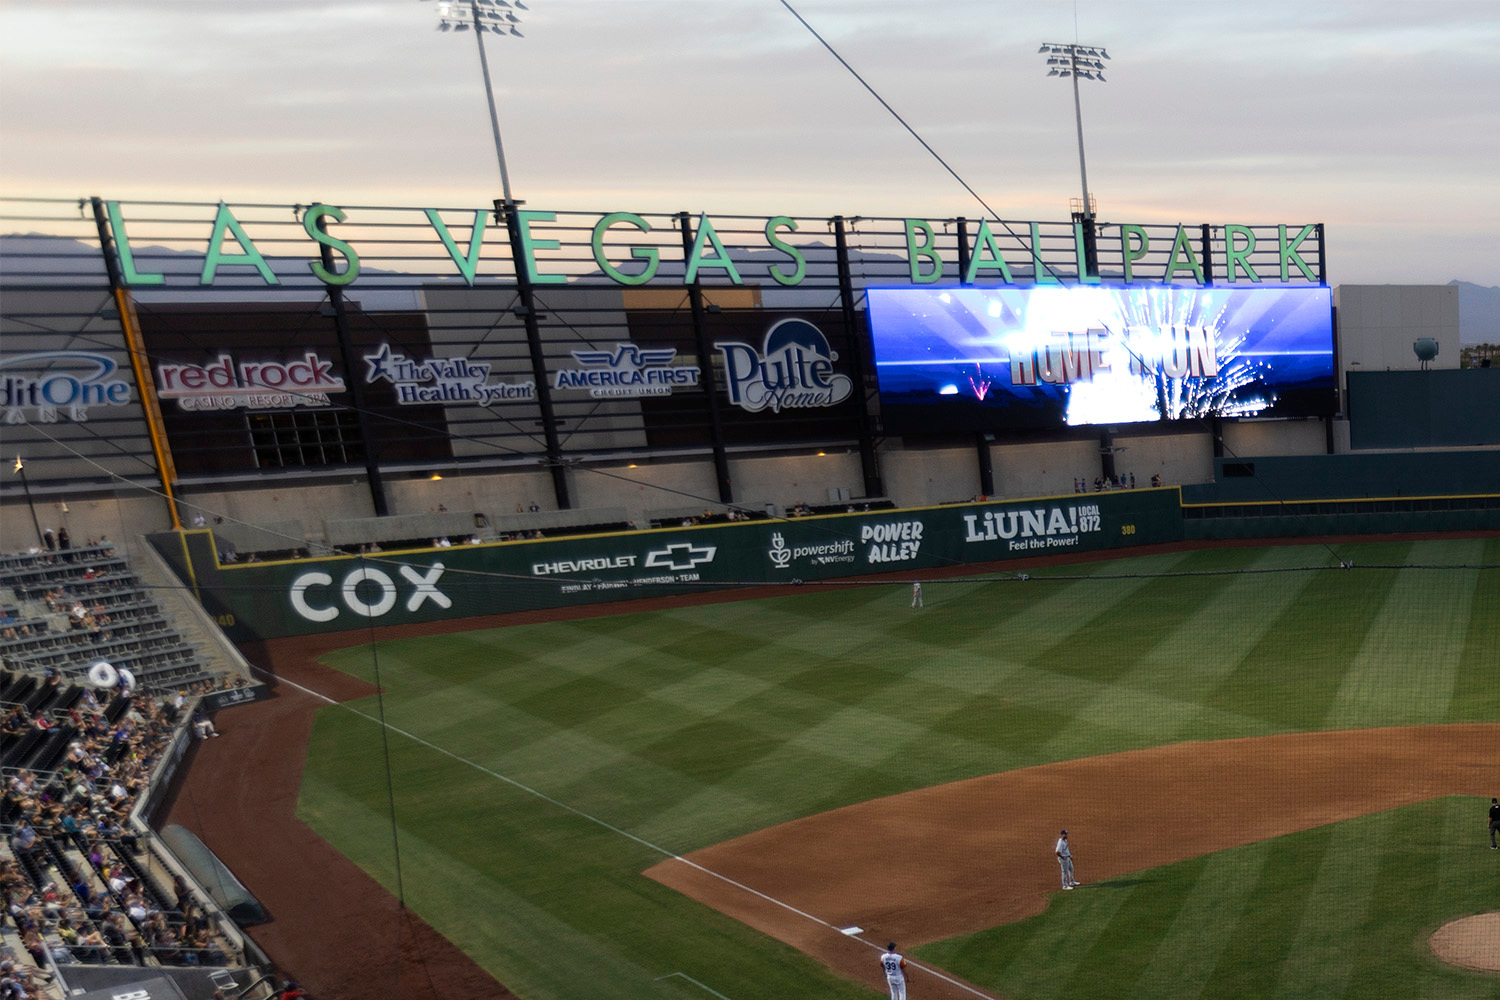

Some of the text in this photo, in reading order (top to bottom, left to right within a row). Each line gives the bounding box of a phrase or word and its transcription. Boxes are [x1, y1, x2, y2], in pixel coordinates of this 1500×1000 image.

[105, 199, 1319, 287] LAS VEGAS BALLPARK
[162, 356, 336, 388] red rock
[396, 360, 490, 382] The Valley
[557, 369, 699, 388] AMERICA FIRST
[716, 344, 833, 402] Pulte
[182, 393, 329, 408] CASINO RESORT SPA
[400, 382, 534, 405] Health System
[592, 387, 673, 397] CREDIT UNION
[752, 377, 848, 411] Homes
[1078, 505, 1100, 517] LOCAL
[861, 521, 924, 543] POWER
[963, 506, 1079, 542] LiUNA!
[1079, 516, 1101, 532] 872
[1121, 524, 1136, 536] 380
[793, 540, 855, 559] powershift
[868, 540, 921, 564] ALLEY
[1009, 535, 1079, 551] Feel the Power!
[532, 555, 637, 576] CHEVROLET
[679, 573, 700, 582] TEAM
[291, 563, 452, 623] COX
[885, 961, 896, 971] 39
